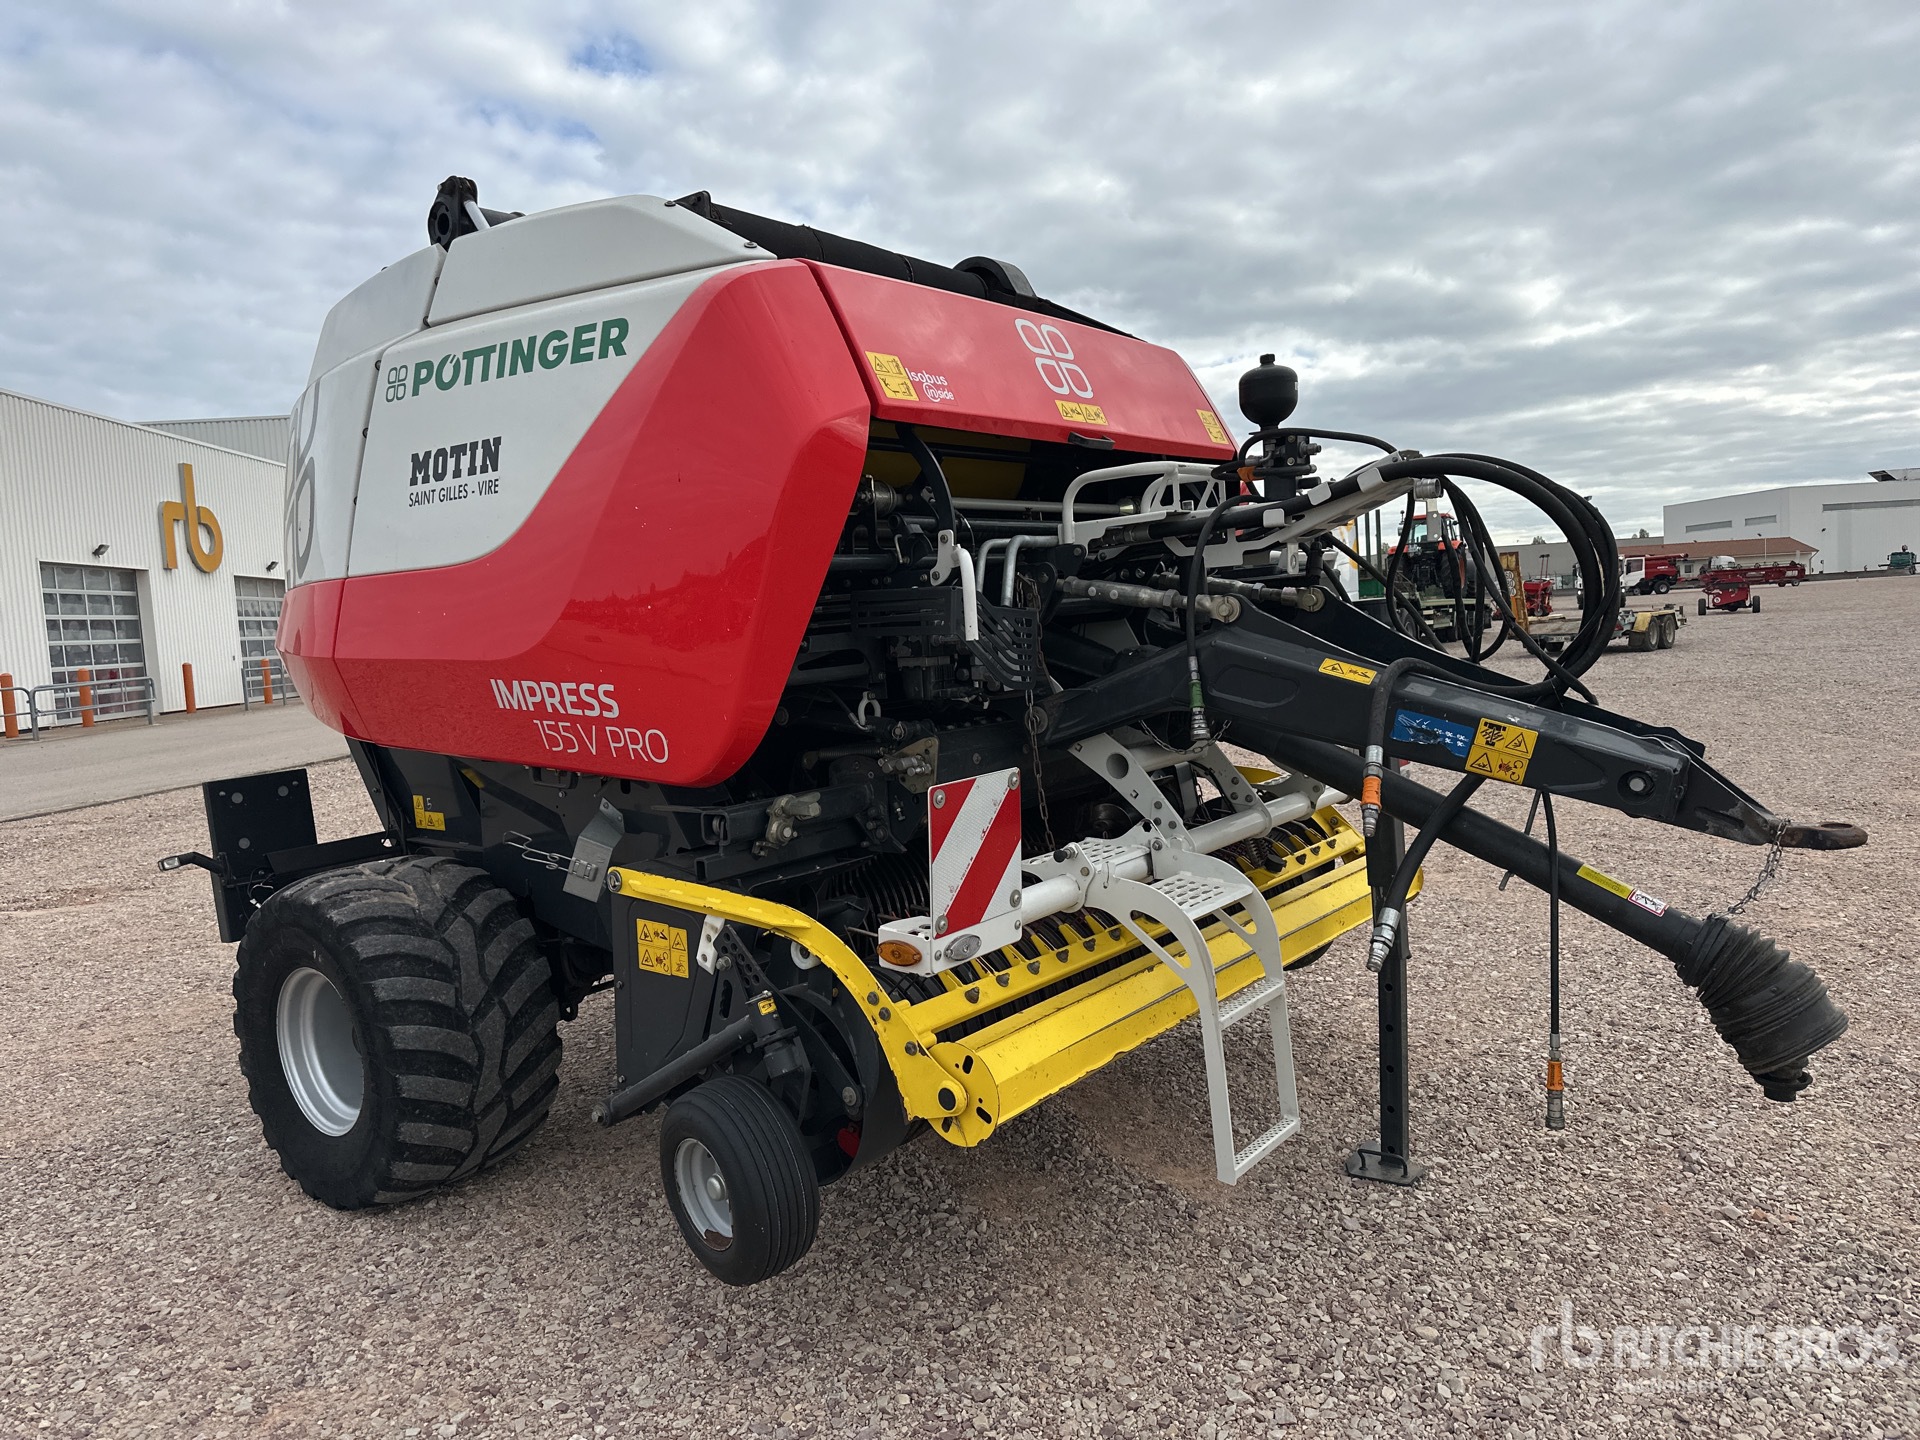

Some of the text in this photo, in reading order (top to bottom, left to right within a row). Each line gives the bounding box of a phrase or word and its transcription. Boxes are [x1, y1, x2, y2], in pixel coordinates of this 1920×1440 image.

[412, 317, 630, 397] PÖTTINGER
[905, 368, 948, 386] Isobus
[409, 436, 502, 486] MOTIN
[408, 489, 436, 507] SAINT
[438, 483, 468, 502] GILLES
[477, 478, 499, 497] VIRE
[157, 462, 224, 573] rb
[489, 678, 620, 718] IMPRESS
[605, 726, 669, 763] PRO
